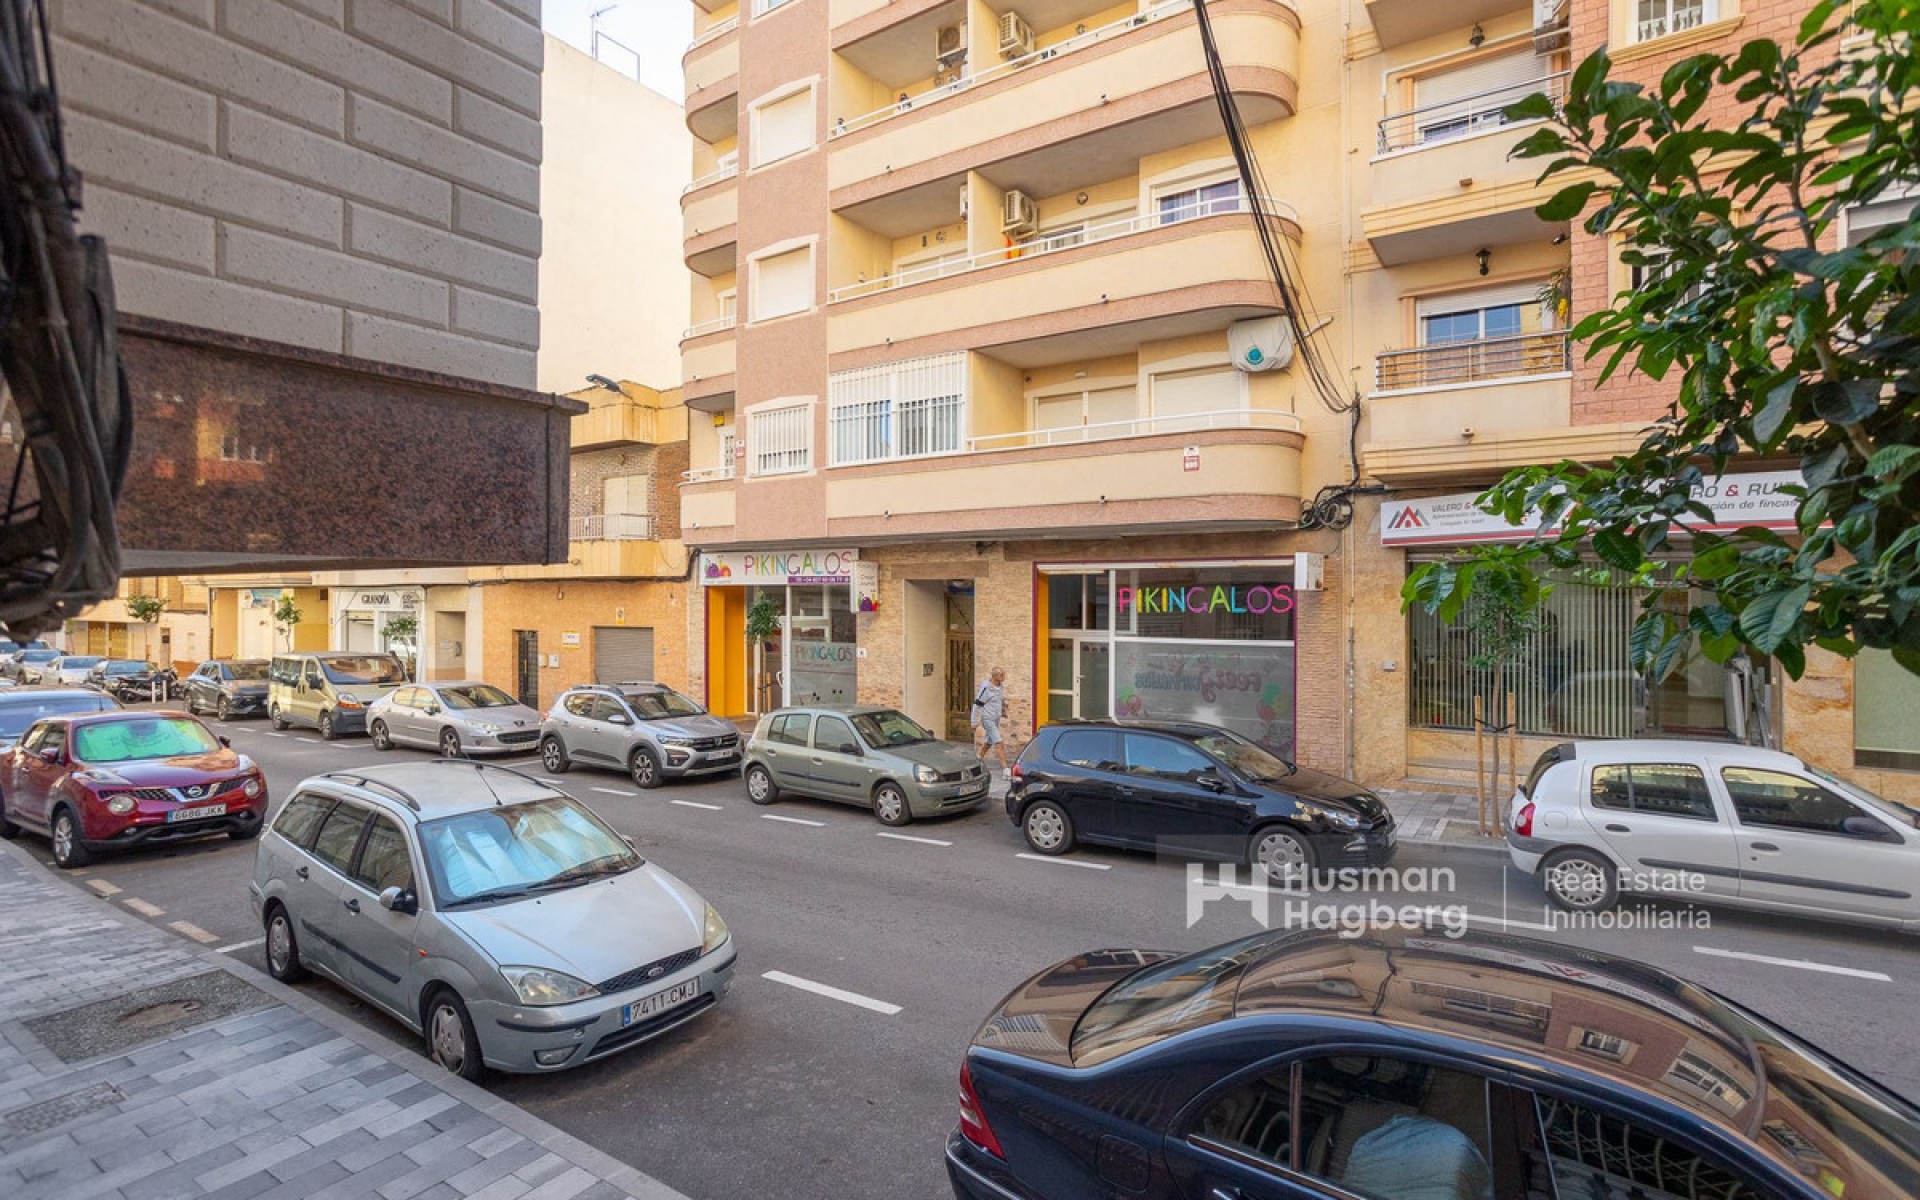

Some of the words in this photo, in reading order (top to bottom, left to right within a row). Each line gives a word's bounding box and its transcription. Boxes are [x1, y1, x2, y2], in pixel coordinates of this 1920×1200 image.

[1431, 502, 1462, 512] VALERO
[1739, 501, 1754, 510] de
[1760, 498, 1798, 508] fincas
[744, 551, 852, 576] PIKINGALOS
[1118, 585, 1294, 614] PIKINGALOS
[632, 993, 665, 1020] 7411
[670, 981, 696, 1004] CMJ
